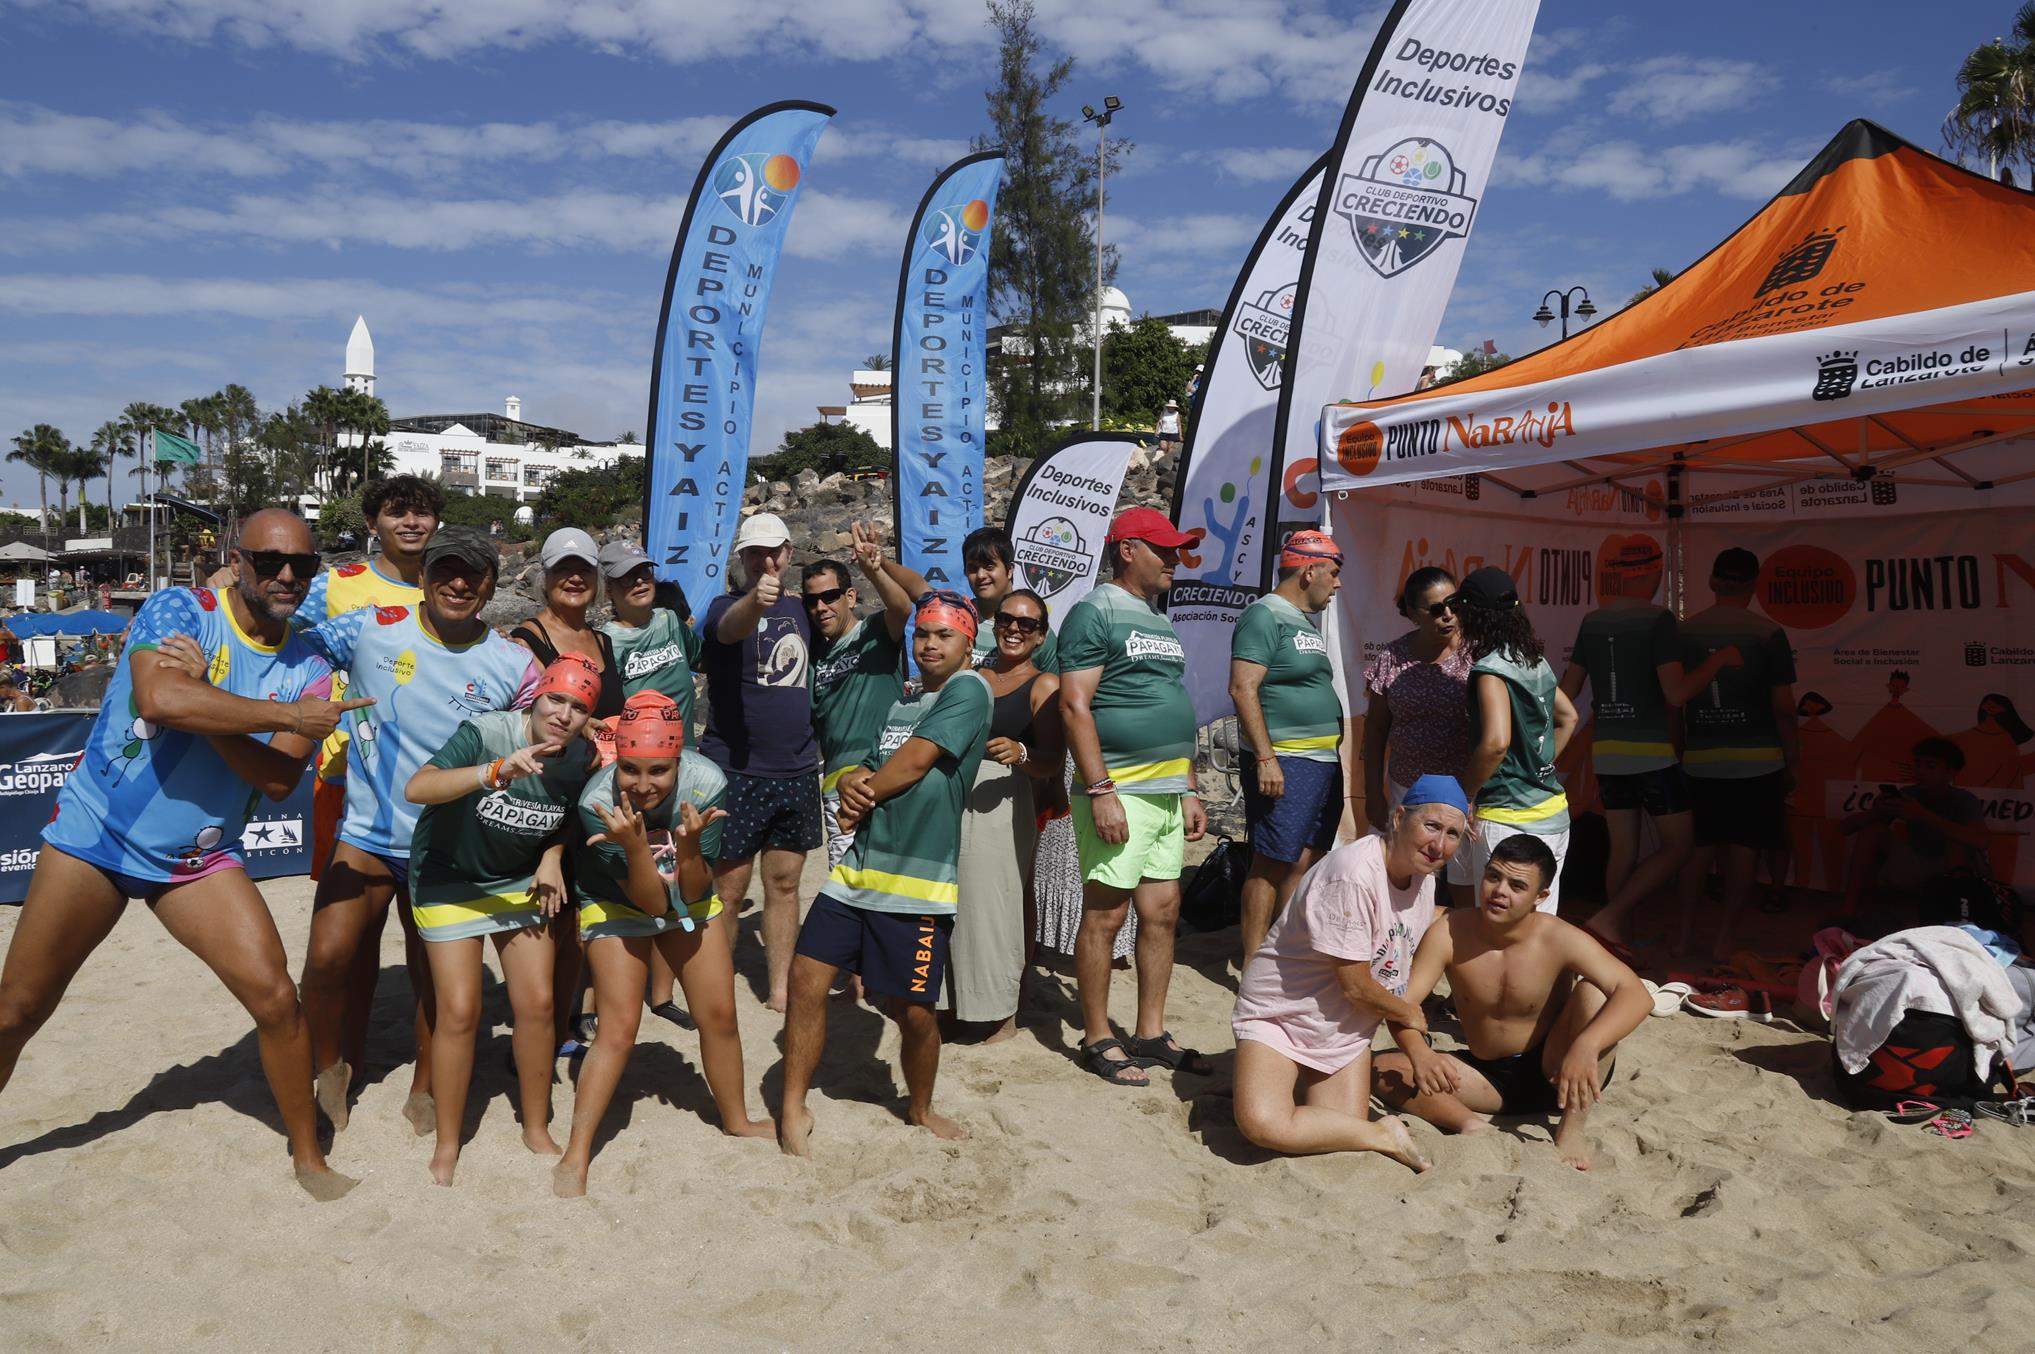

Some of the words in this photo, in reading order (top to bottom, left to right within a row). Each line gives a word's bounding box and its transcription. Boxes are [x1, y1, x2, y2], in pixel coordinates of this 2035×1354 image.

[1396, 37, 1517, 81] Deportes
[1374, 69, 1511, 117] Inclusivos
[1342, 192, 1465, 229] CRECIENDO
[1365, 185, 1391, 198] CLUB
[1392, 190, 1448, 207] DEPORTIVO
[1820, 281, 1866, 298] de
[1259, 314, 1279, 327] CLUB
[723, 263, 763, 435] MUNICIPIO
[1867, 351, 1952, 377] Cabildo
[1960, 346, 1991, 364] de
[960, 295, 973, 444] MUNICIPIO
[1387, 418, 1441, 461] PUNTO
[1040, 464, 1113, 496] Deportes
[664, 442, 707, 581] YAIZ
[1026, 483, 1111, 518] Inclusivos
[704, 460, 731, 578] ACTIVO
[1016, 549, 1086, 573] CRECIENDO
[1028, 544, 1045, 553] CLUB
[1045, 547, 1077, 560] DEPORTIVO
[1775, 566, 1834, 578] Equipo
[1865, 554, 1980, 612] PUNTO
[1172, 610, 1217, 624] Asociación
[376, 661, 412, 676] Inclusivo
[383, 656, 415, 670] Deporte
[542, 804, 566, 813] PLAYAS
